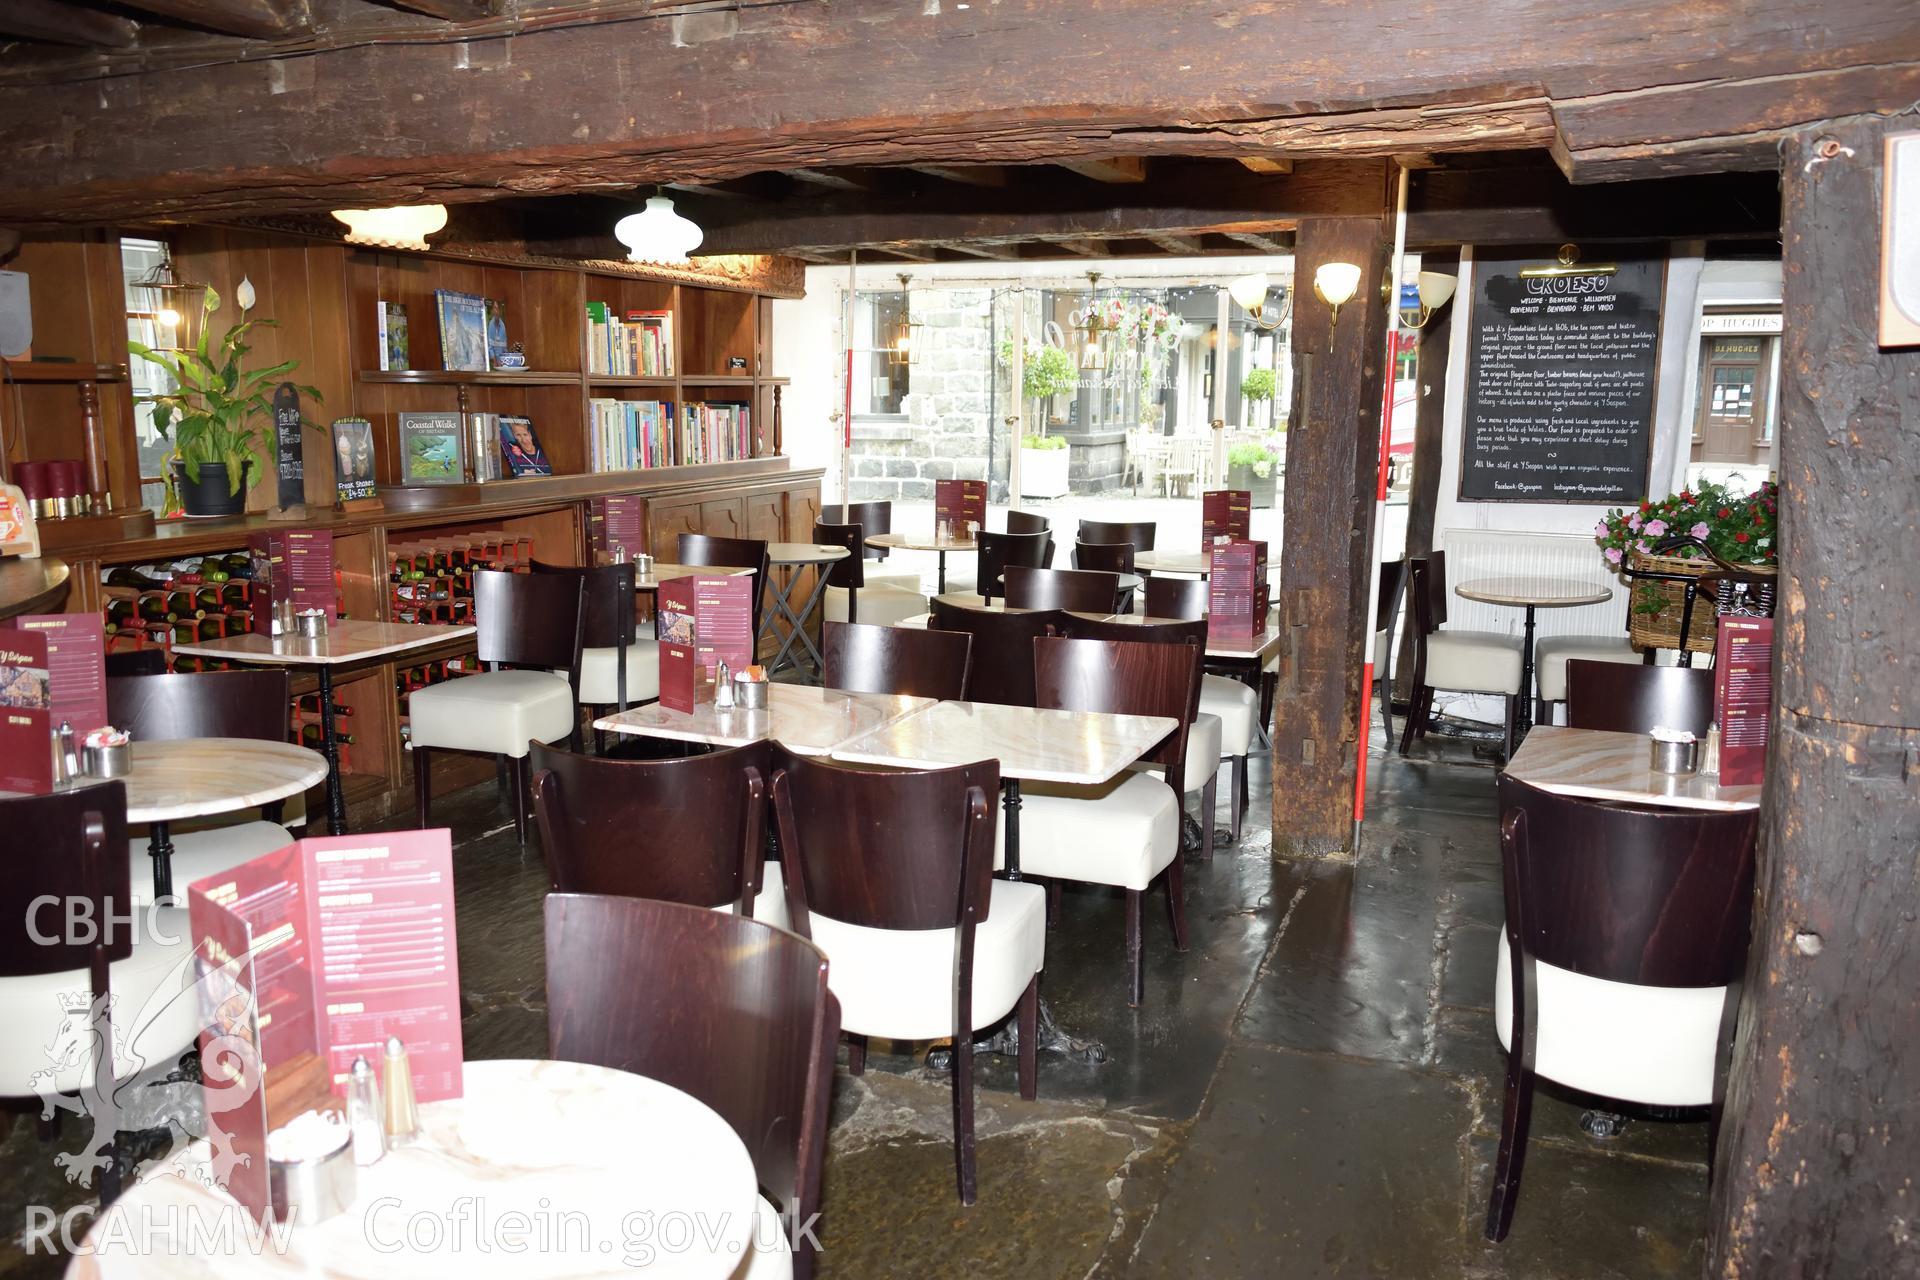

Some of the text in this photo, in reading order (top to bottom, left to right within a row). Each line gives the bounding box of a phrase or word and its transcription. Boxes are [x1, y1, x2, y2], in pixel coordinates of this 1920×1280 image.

[1521, 296, 1543, 304] WELCOME
[1585, 294, 1616, 302] WILLKOMMEN
[1547, 305, 1577, 313] BIENVENIDO
[1598, 304, 1614, 312] VINDO
[1723, 318, 1779, 328] HUGHES
[1508, 325, 1536, 334] foundations
[1483, 334, 1499, 342] format
[1541, 334, 1555, 343] today
[1481, 344, 1500, 352] original
[1537, 344, 1552, 352] ground
[1497, 353, 1508, 361] floor
[1490, 371, 1508, 379] original
[1511, 370, 1533, 380] flagstone
[1580, 370, 1592, 378] (mind
[1479, 379, 1490, 388] front
[1513, 380, 1533, 388] fireplace
[1479, 388, 1484, 396] of
[1548, 390, 1561, 398] plaster
[1479, 398, 1495, 407] history
[407, 419, 457, 429] Coastal Walks
[1510, 417, 1531, 425] produced
[1552, 416, 1564, 425] fresh
[1591, 418, 1619, 427] ingredients
[1630, 419, 1640, 427] give
[1561, 426, 1573, 434] food
[1583, 427, 1605, 436] prepared
[1477, 435, 1492, 444] please
[1532, 437, 1542, 445] may
[1544, 436, 1570, 444] experience
[1595, 437, 1609, 446] delay
[1613, 437, 1628, 446] during
[1475, 460, 1483, 468] All
[1497, 461, 1510, 470] staff
[1559, 465, 1568, 473] you
